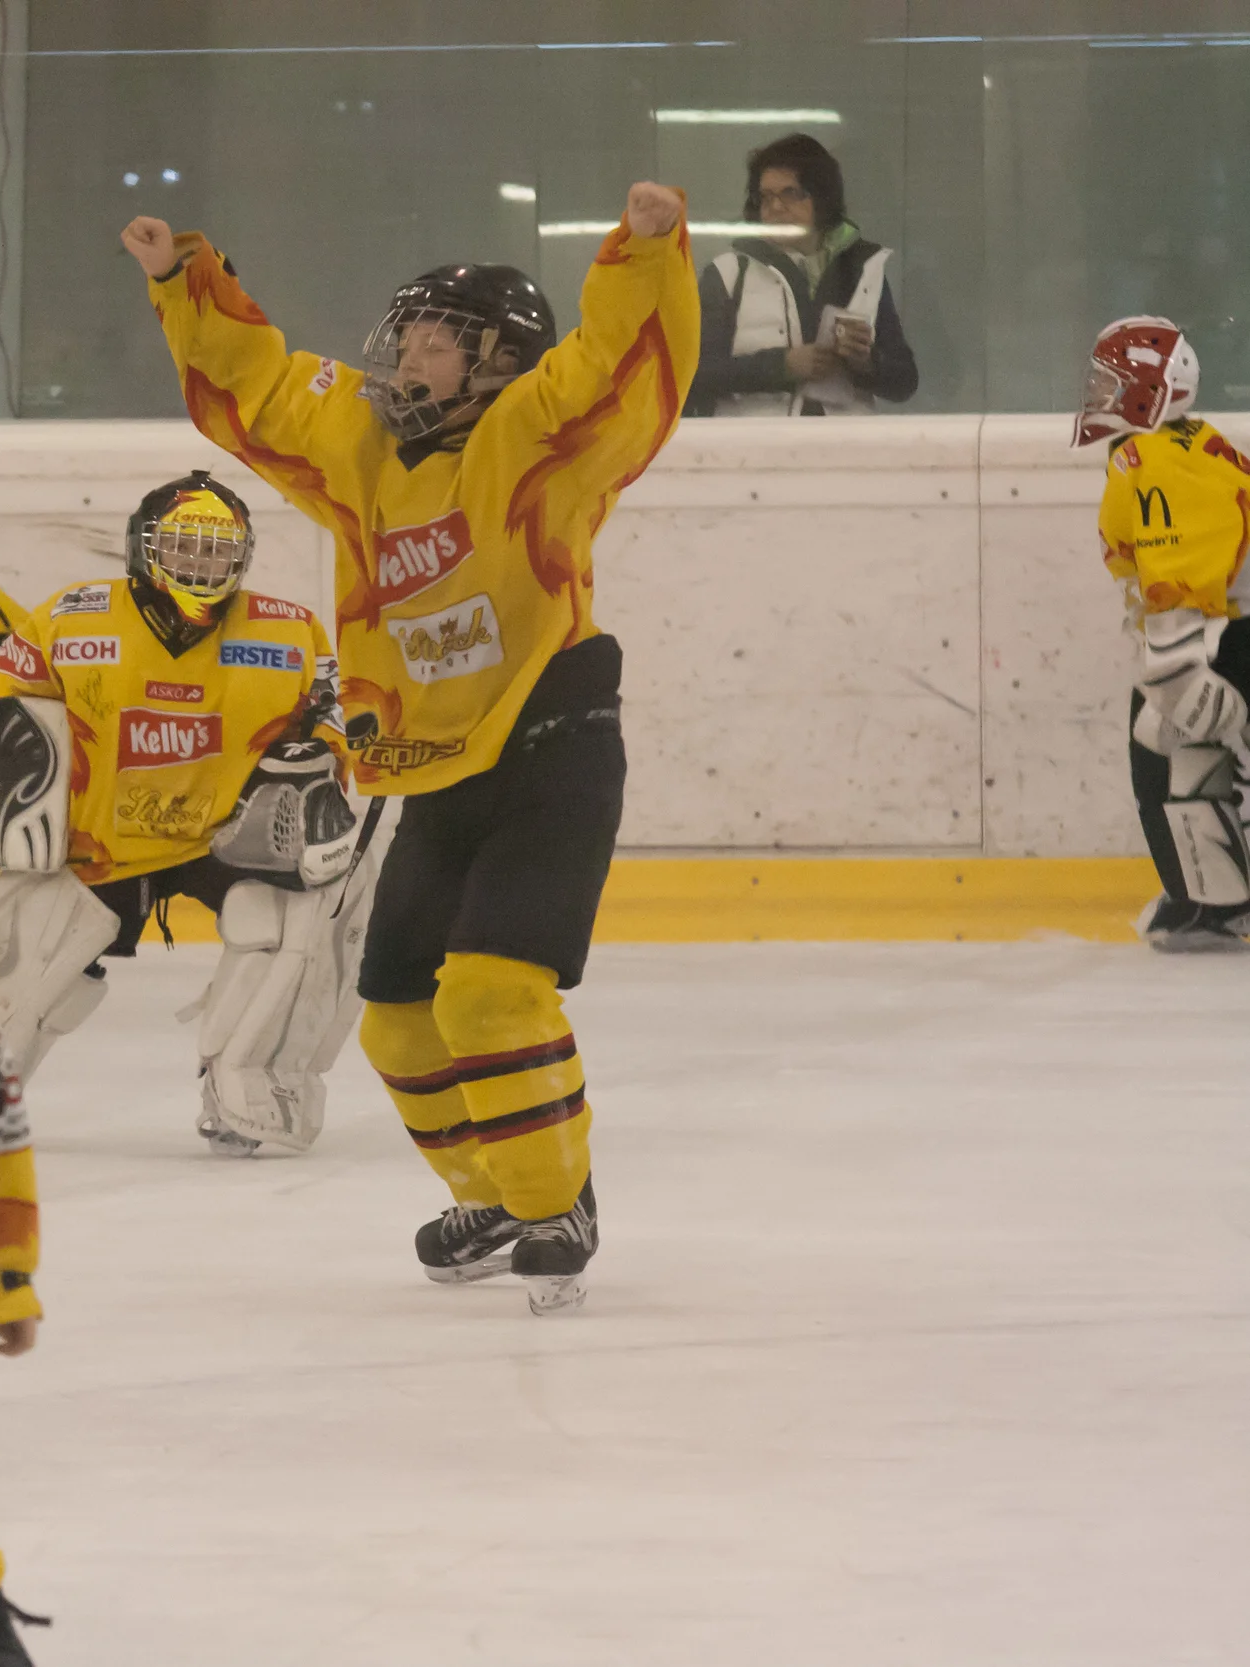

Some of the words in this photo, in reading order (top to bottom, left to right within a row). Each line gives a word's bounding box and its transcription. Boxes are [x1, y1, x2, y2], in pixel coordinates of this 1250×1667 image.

[172, 511, 234, 528] Lorenzo
[256, 600, 307, 619] Kelly's
[52, 641, 116, 661] RICOH
[221, 645, 283, 668] ERSTE
[130, 720, 209, 759] Kelly's
